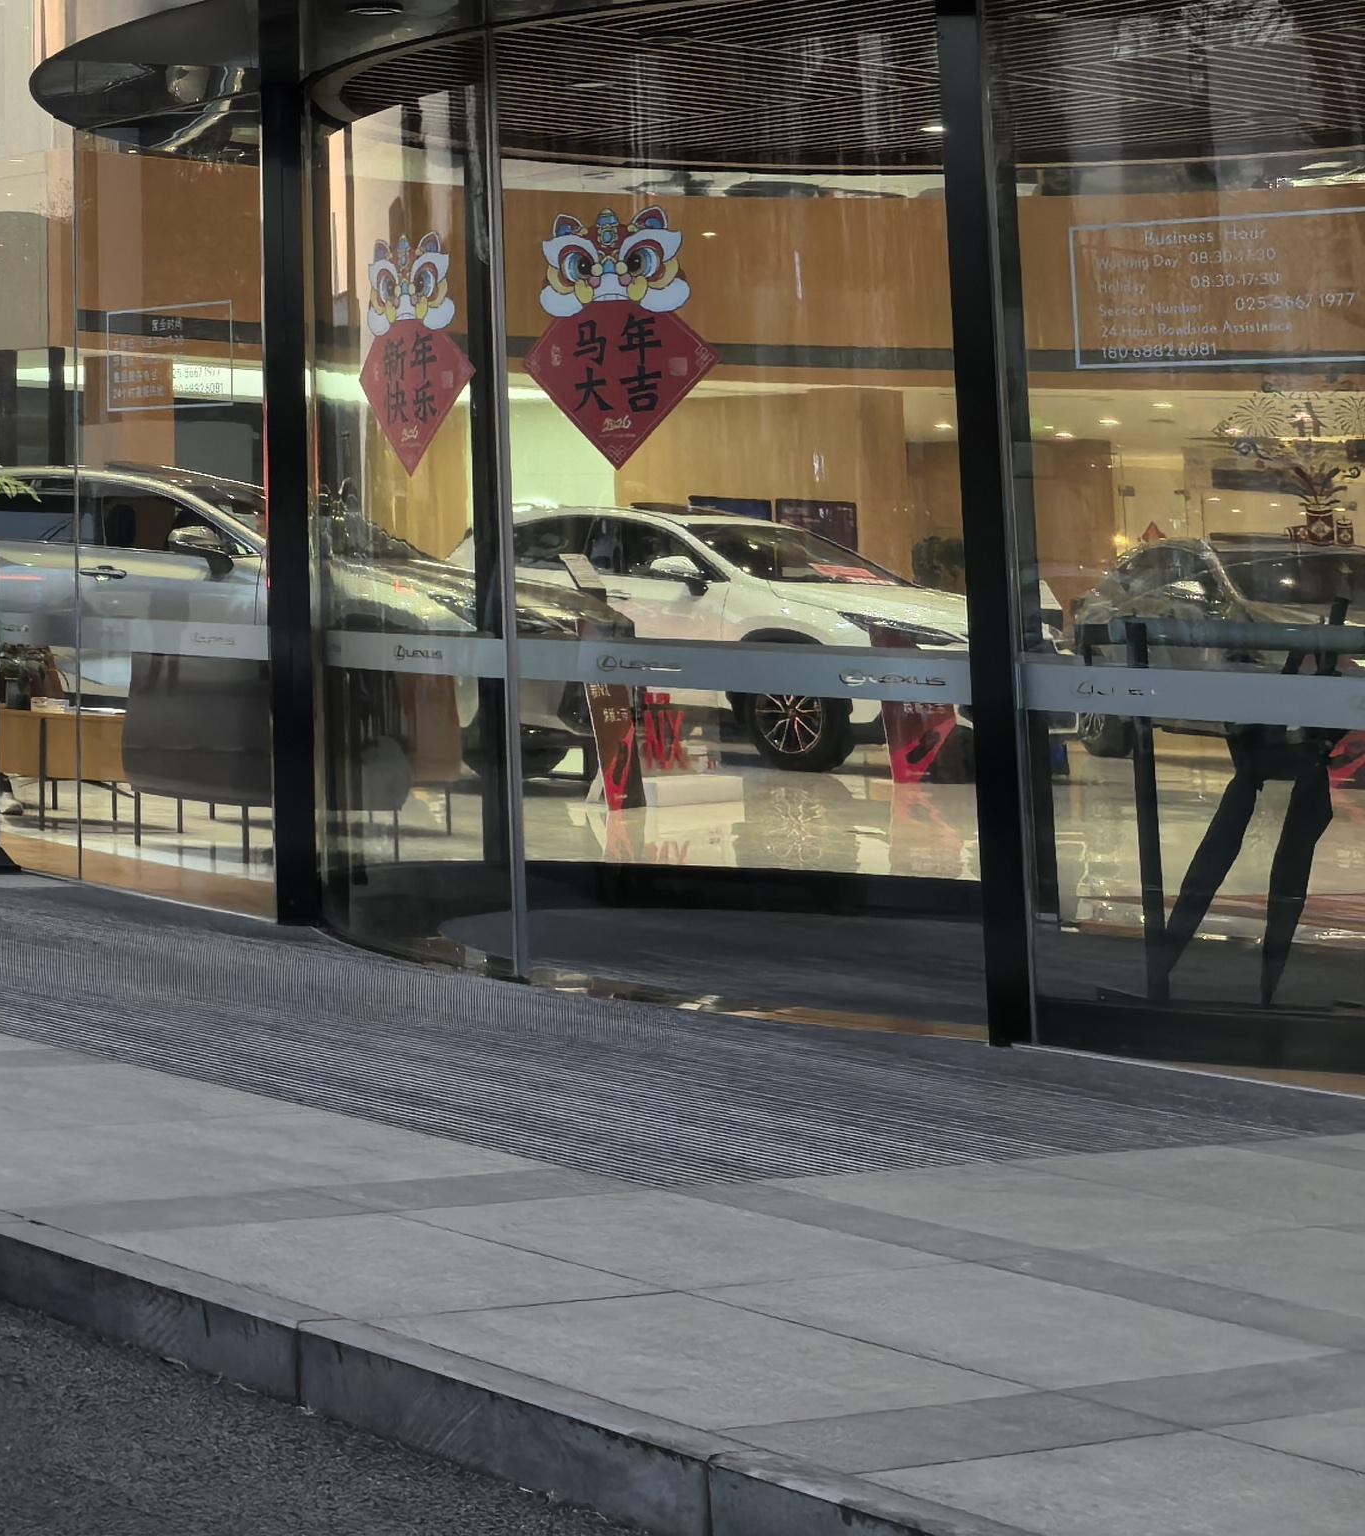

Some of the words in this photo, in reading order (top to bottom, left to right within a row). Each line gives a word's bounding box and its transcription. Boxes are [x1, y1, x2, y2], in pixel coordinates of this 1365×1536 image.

[1145, 231, 1214, 246] Business
[383, 331, 438, 381] 新年
[573, 313, 663, 367] 马年
[383, 379, 438, 425] 快乐
[574, 364, 663, 413] 大吉
[644, 709, 689, 770] NX
